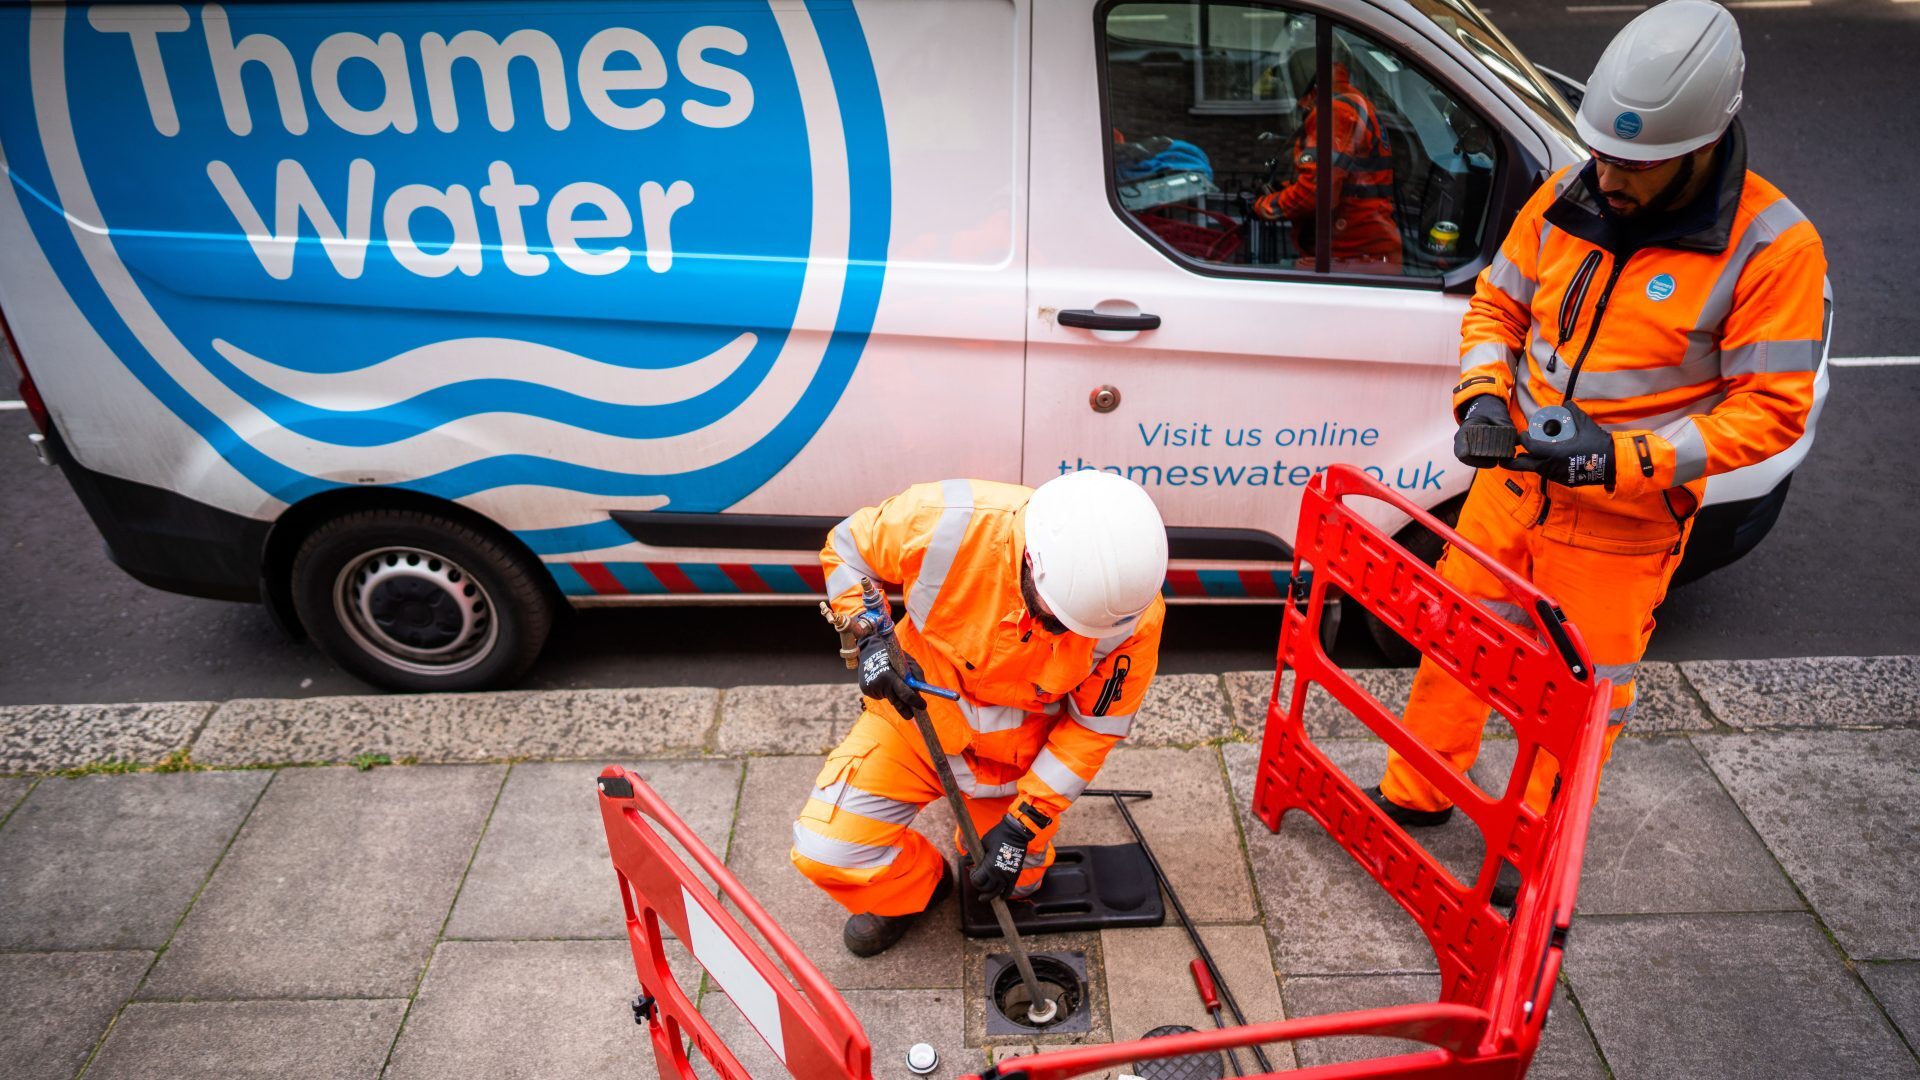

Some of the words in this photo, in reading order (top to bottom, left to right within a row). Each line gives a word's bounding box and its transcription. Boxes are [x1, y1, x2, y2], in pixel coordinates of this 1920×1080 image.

[88, 3, 755, 137] Thames
[206, 158, 695, 280] Water
[1138, 422, 1212, 447] Visit
[1225, 427, 1262, 447] us
[1275, 422, 1380, 447] online
[1058, 457, 1445, 490] tmeswateo.uk
